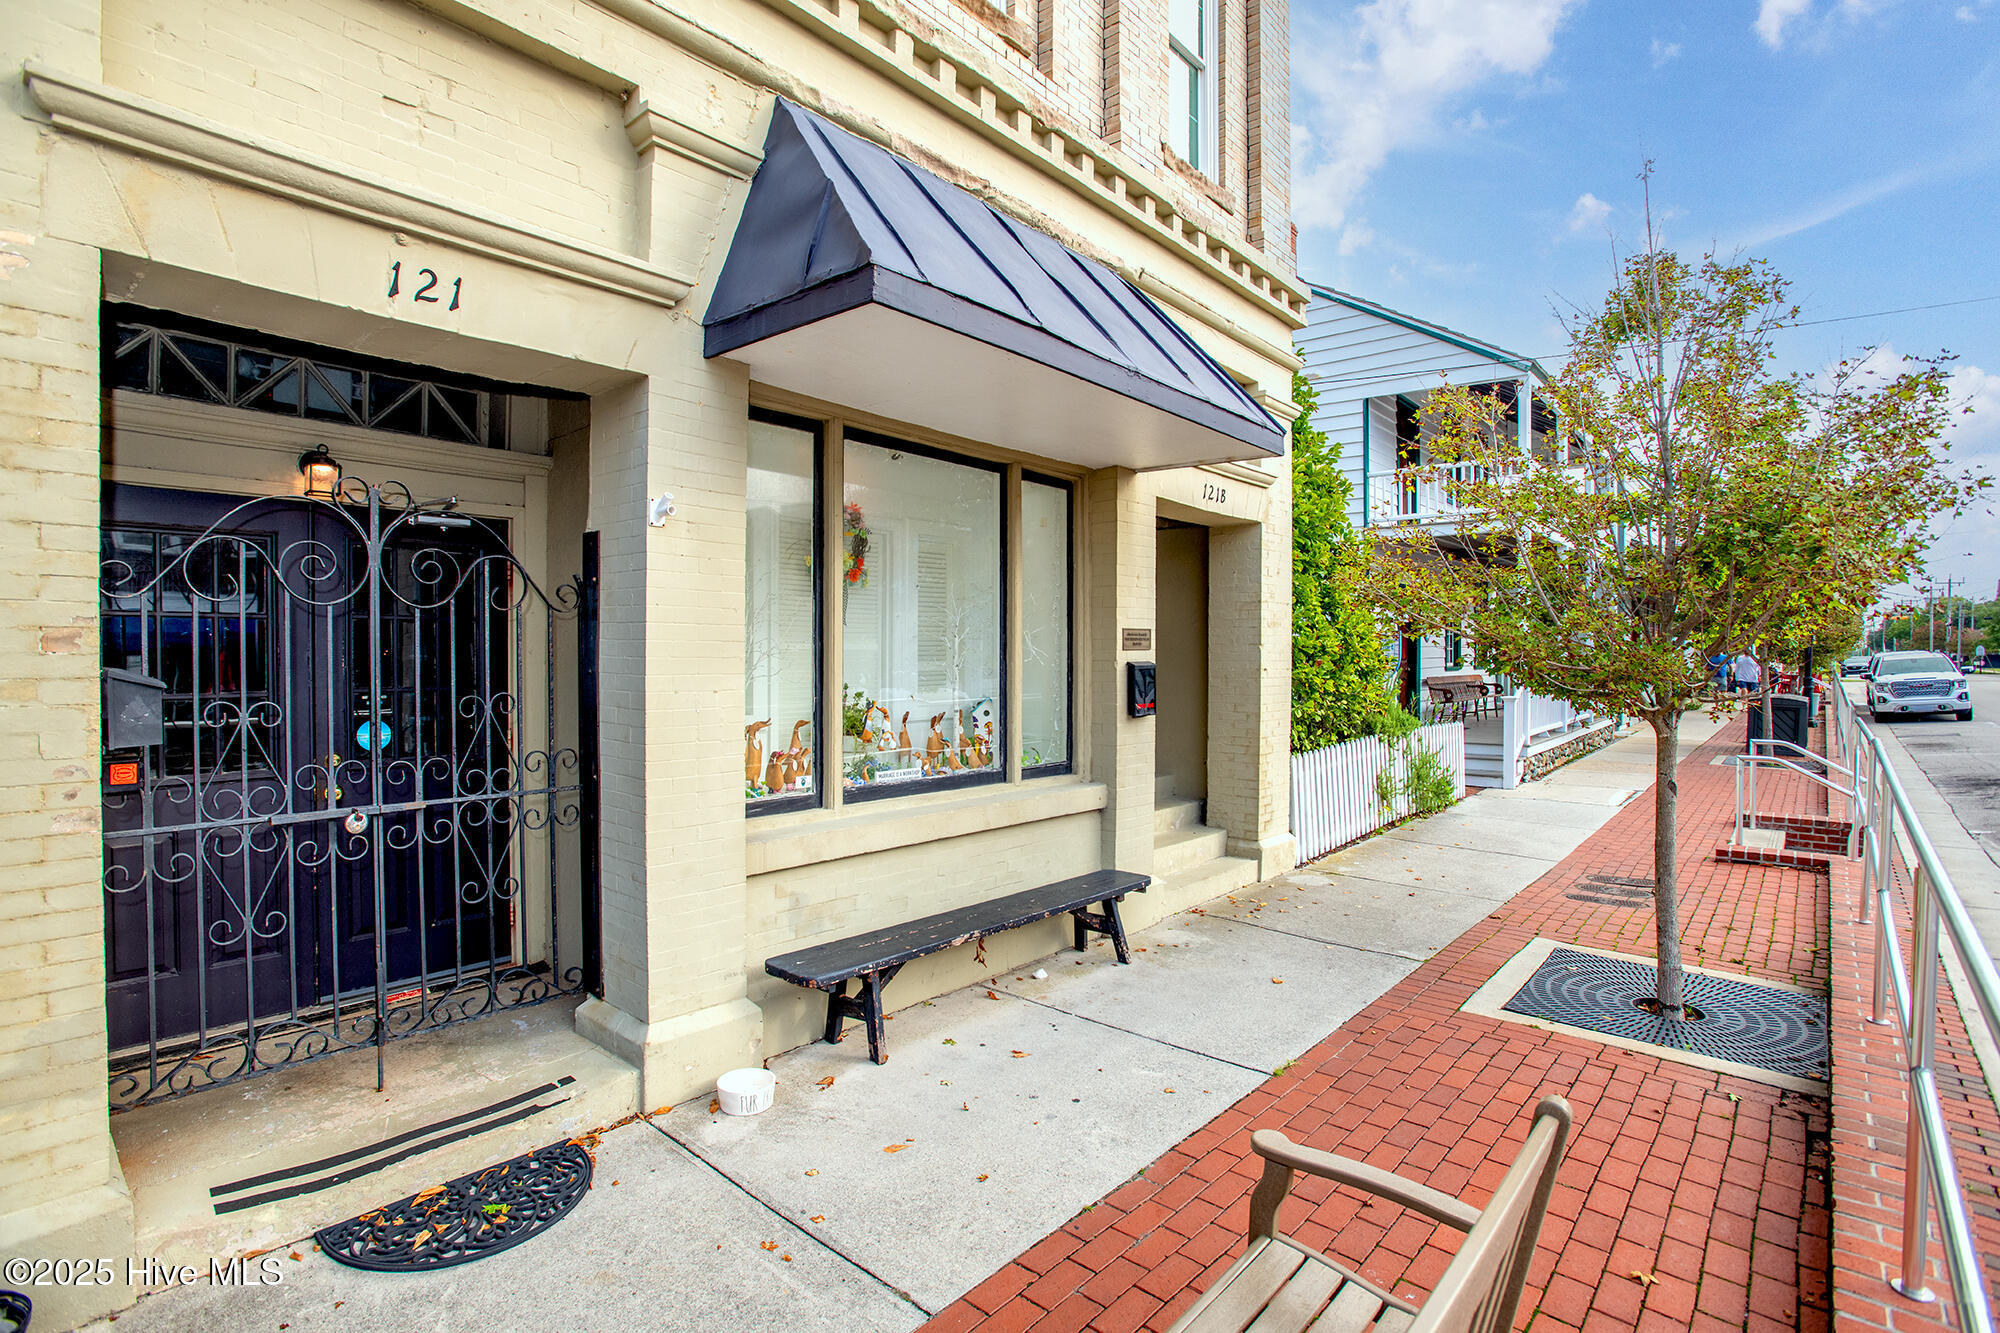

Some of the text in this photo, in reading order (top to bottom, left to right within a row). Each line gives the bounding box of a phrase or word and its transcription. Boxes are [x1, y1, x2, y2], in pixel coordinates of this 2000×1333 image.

[388, 260, 462, 311] 121
[1203, 483, 1226, 503] 121B
[740, 1094, 758, 1113] FUR
